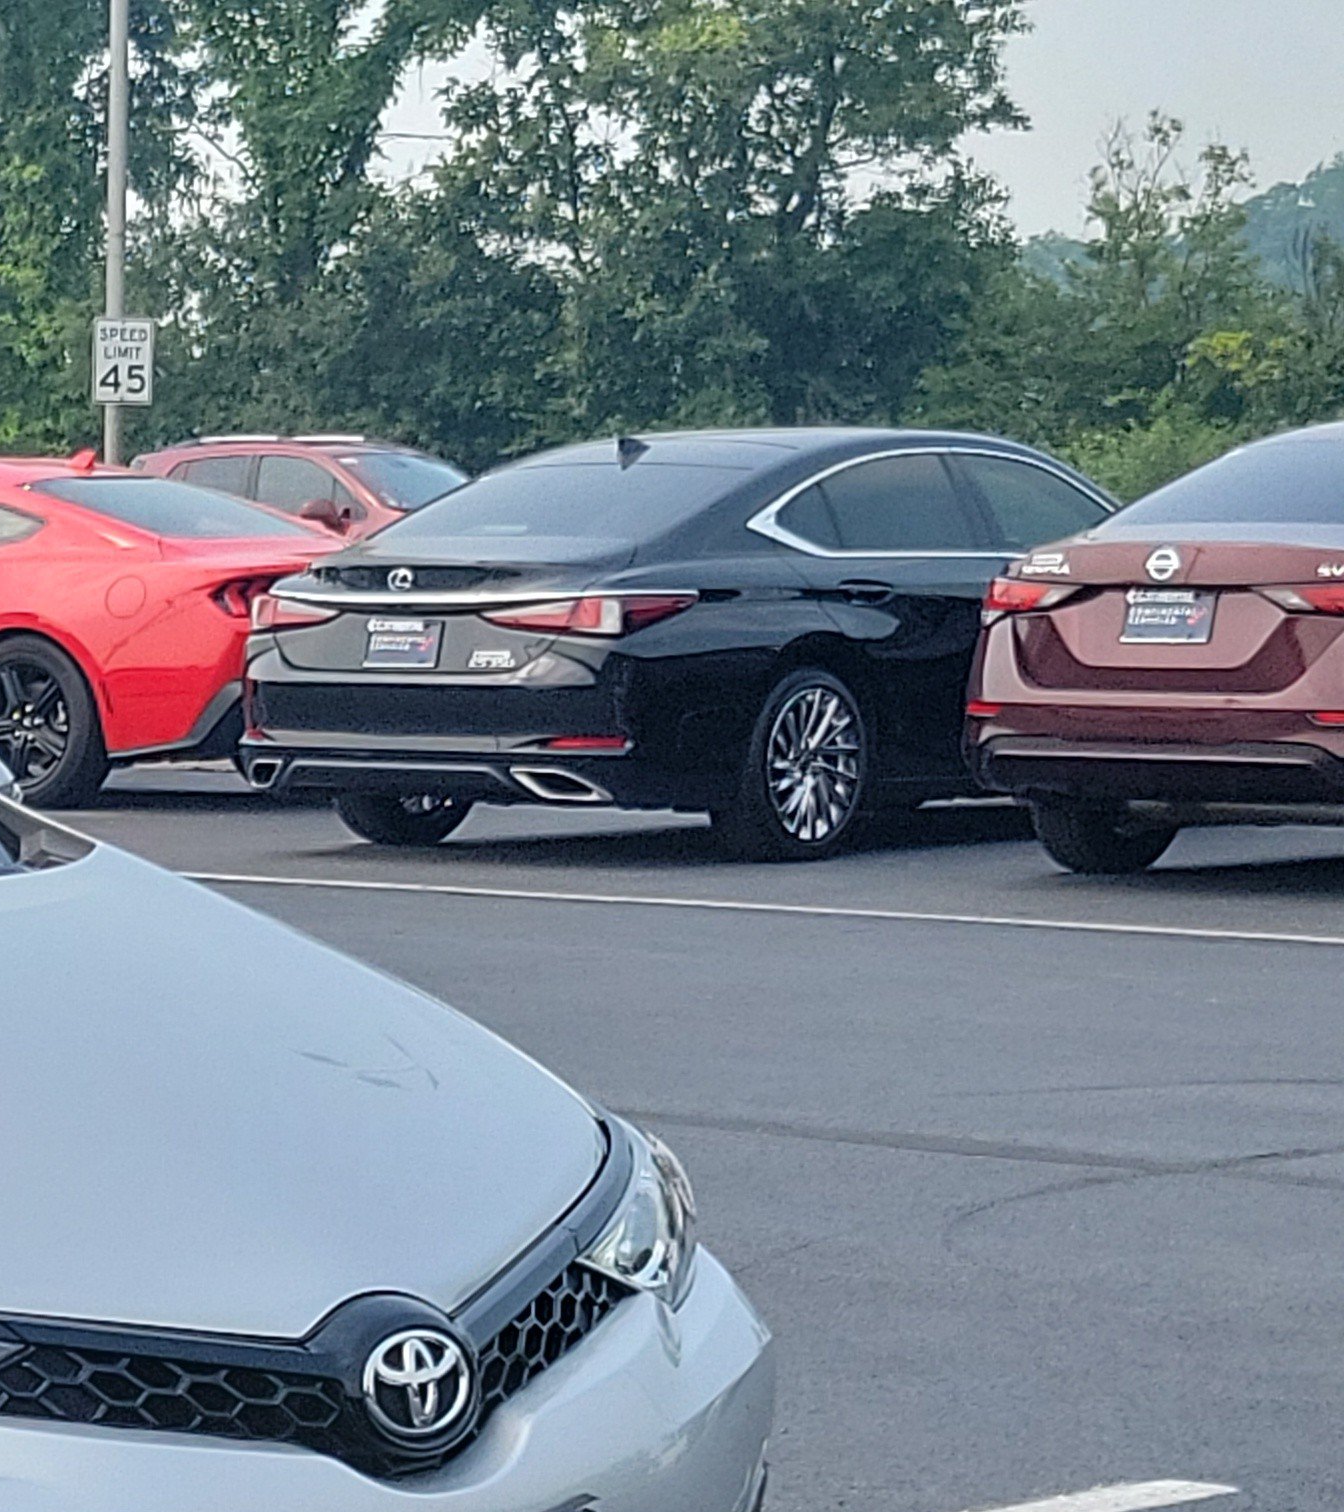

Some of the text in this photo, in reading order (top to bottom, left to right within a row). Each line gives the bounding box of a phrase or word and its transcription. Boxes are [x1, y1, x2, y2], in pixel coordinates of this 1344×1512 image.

[99, 327, 148, 342] SPEED
[103, 346, 143, 360] LIMIT
[99, 364, 146, 394] 45
